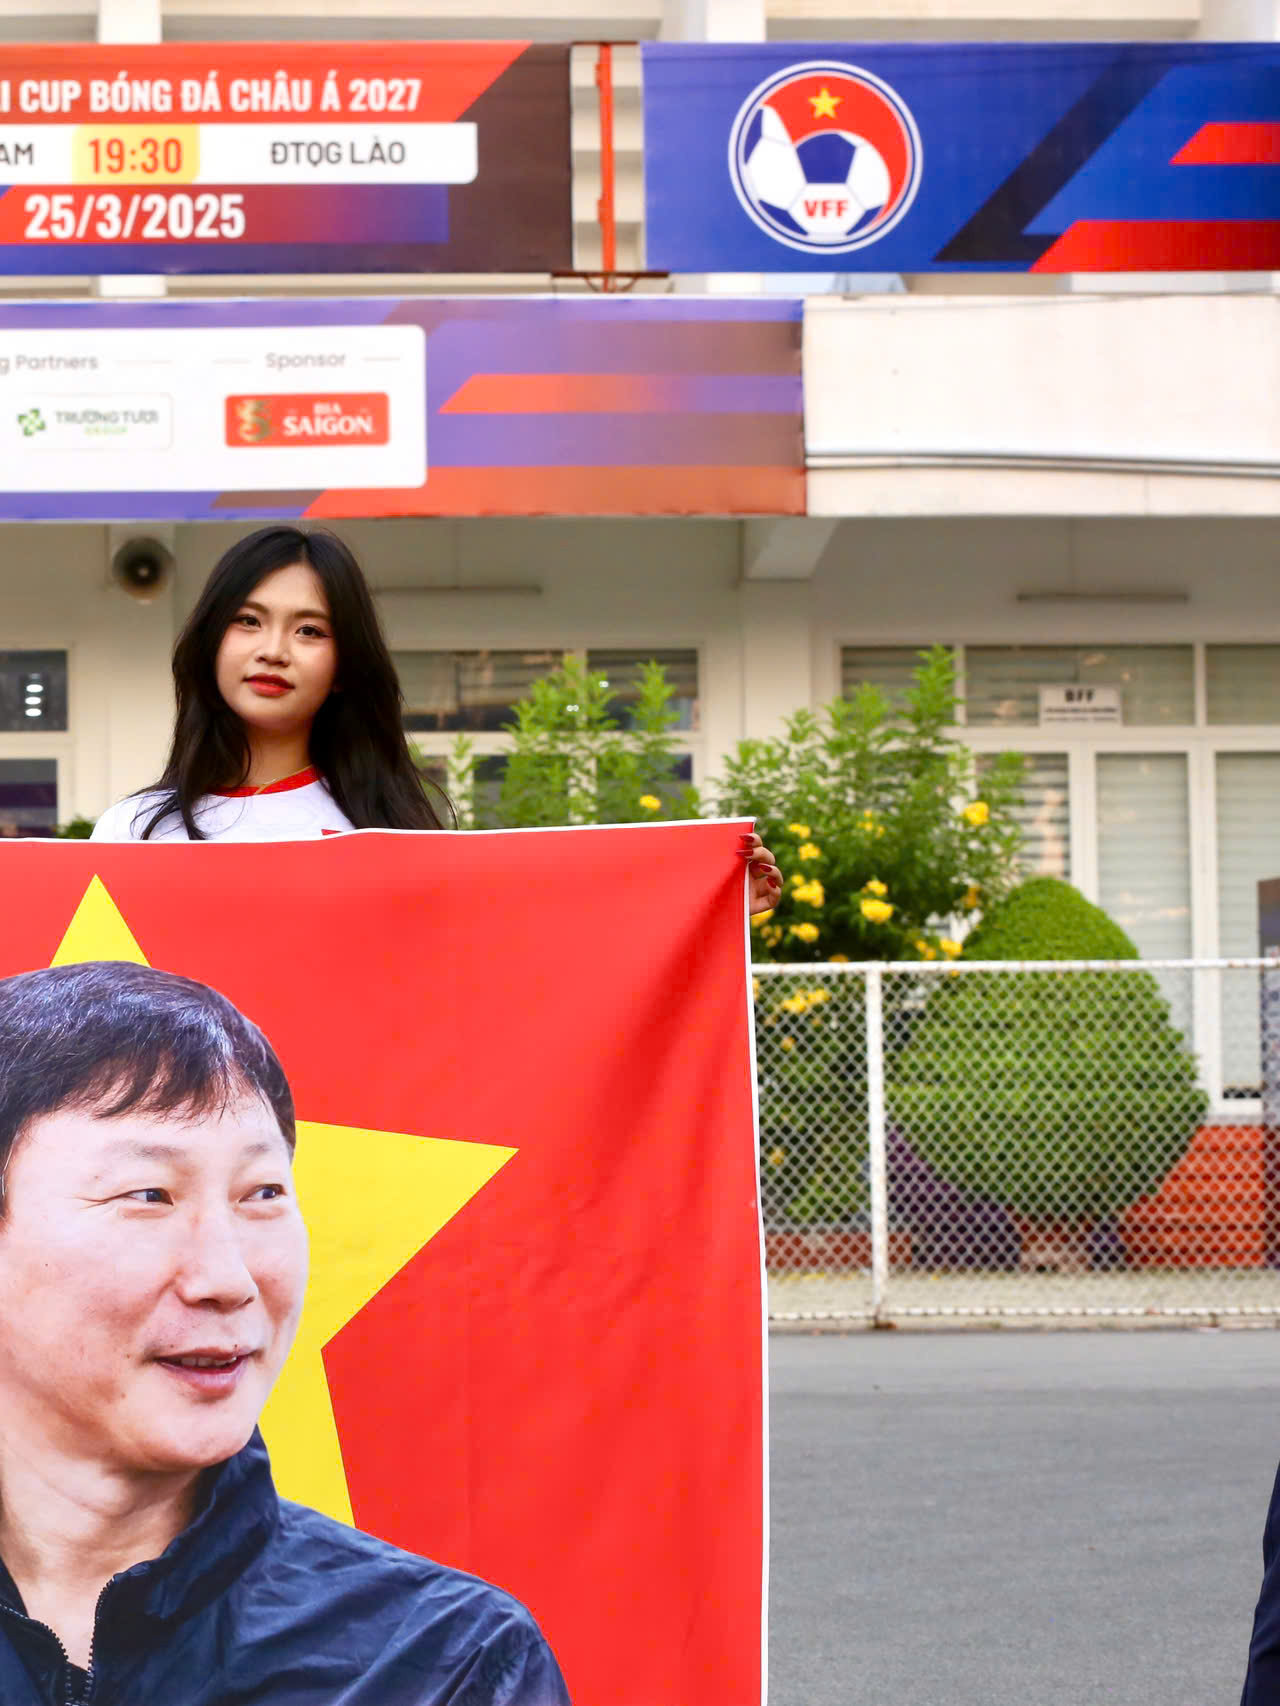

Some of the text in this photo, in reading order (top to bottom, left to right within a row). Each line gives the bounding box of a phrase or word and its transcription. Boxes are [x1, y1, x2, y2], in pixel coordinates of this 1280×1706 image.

[20, 80, 81, 113] CUP
[89, 71, 173, 113] BÓNG
[181, 70, 221, 112] ĐÁ
[229, 69, 312, 112] CHÂU
[321, 70, 341, 112] Á
[349, 78, 422, 111] 2027
[88, 138, 182, 174] 19:30
[270, 136, 406, 167] ĐTQG LÀO
[24, 193, 246, 240] 25/3/2025
[804, 200, 848, 217] VFF
[16, 354, 97, 370] Partners
[265, 352, 346, 371] Sponsor
[282, 415, 373, 436] SAIGON
